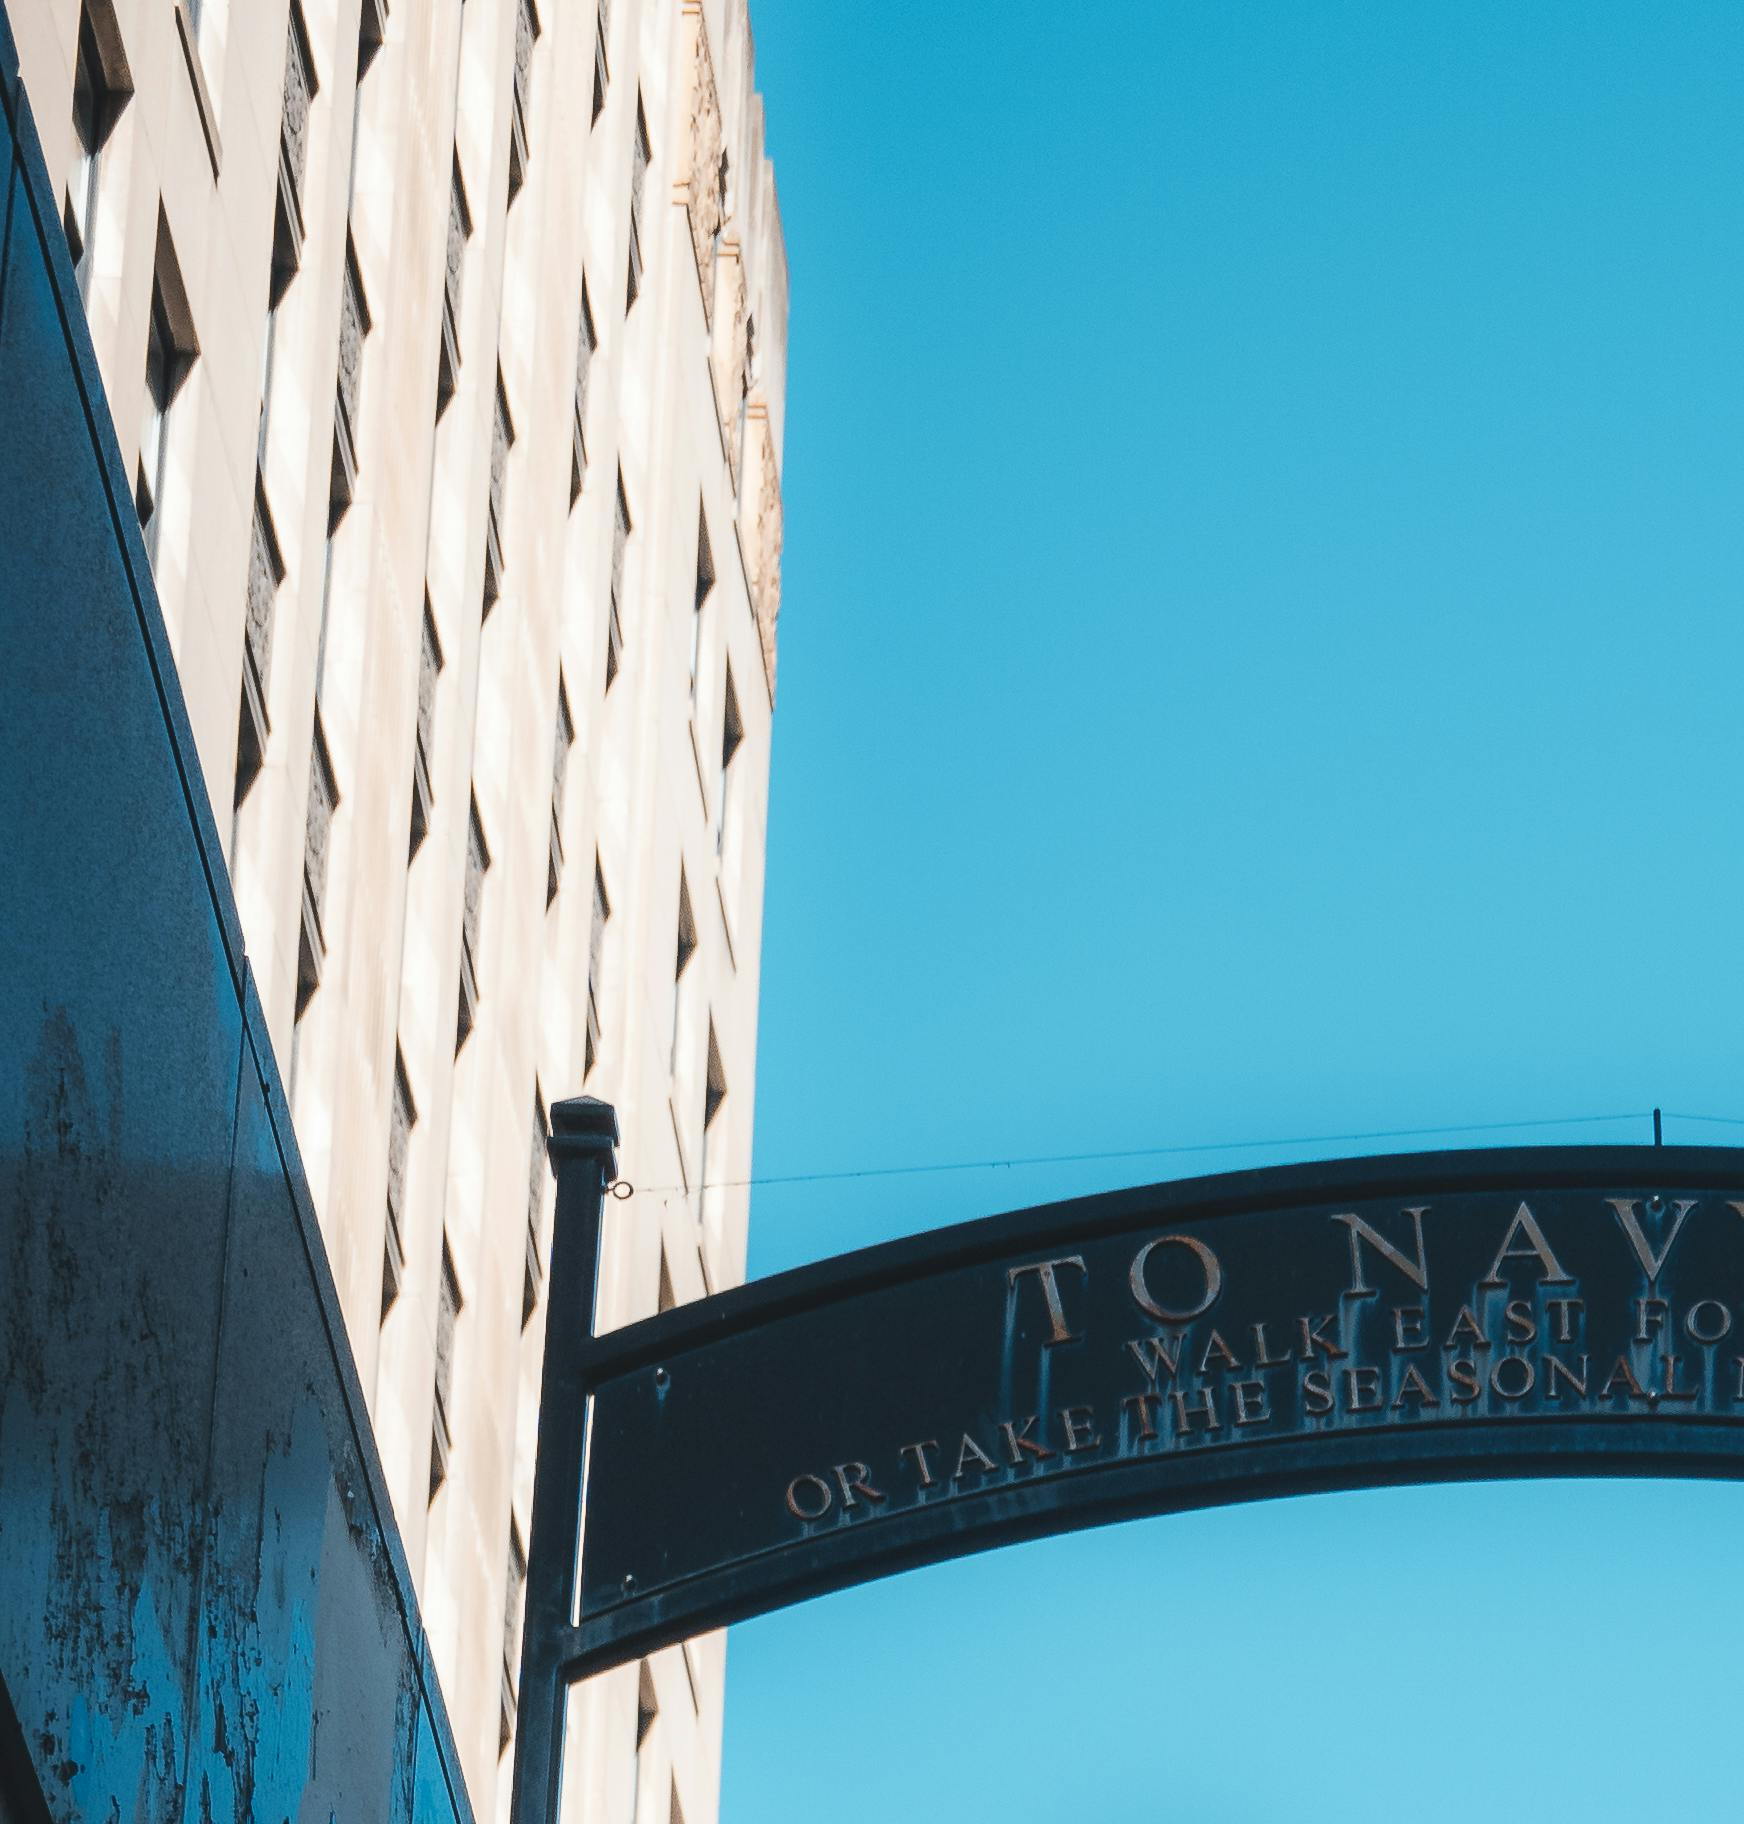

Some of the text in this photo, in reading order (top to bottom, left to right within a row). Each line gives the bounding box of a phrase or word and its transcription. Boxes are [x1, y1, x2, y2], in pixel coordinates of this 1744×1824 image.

[1007, 1233, 1222, 1346] TO
[1126, 1314, 1348, 1381] WALK
[1392, 1299, 1584, 1351] EAST
[785, 1460, 886, 1520] OR
[901, 1406, 1101, 1487] TAKE
[1122, 1381, 1271, 1440] THE
[1303, 1353, 1697, 1415] SEASONAL
